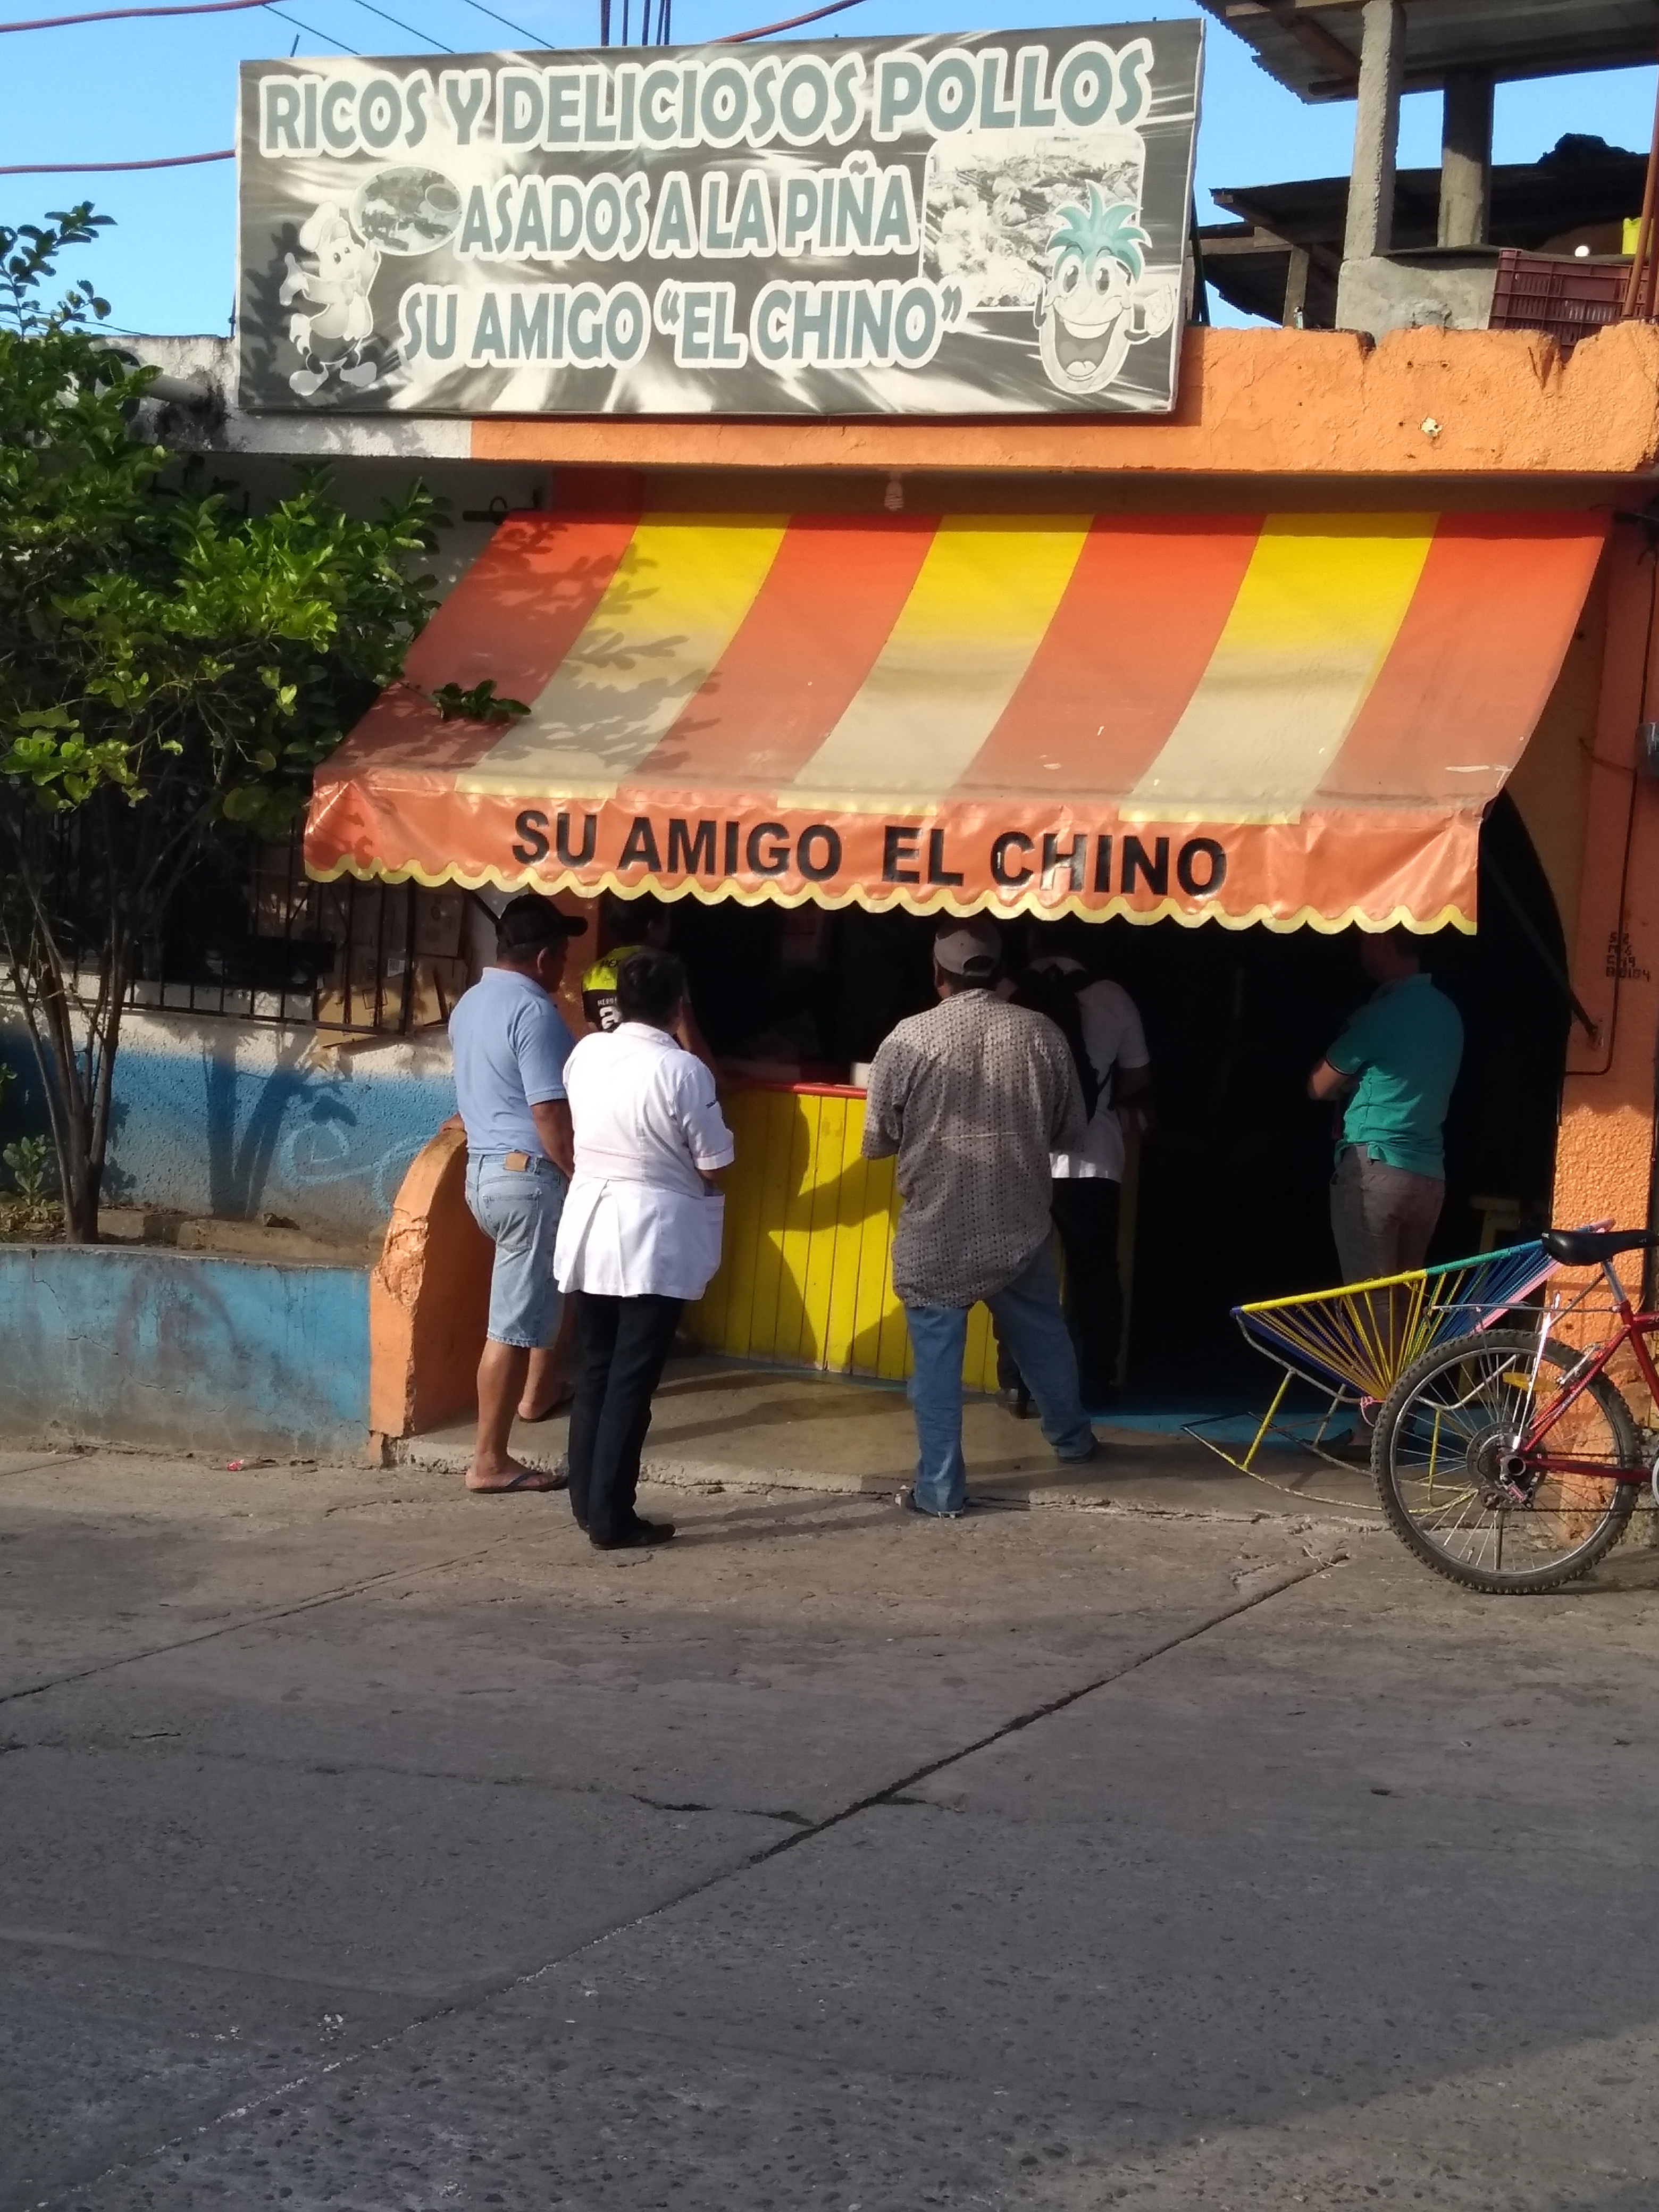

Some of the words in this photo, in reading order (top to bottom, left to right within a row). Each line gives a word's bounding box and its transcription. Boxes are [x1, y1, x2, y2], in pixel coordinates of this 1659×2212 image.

[264, 77, 429, 151] RICOS
[443, 77, 486, 147] Y
[501, 61, 861, 146] DELICIOSOS
[877, 46, 1147, 135] POLLOS
[458, 179, 646, 254] ASADOS
[653, 179, 692, 252] A
[705, 176, 771, 250] LA
[783, 159, 913, 249] PIÑA
[401, 290, 457, 363] SU
[471, 290, 641, 363] AMIGO
[512, 809, 597, 868] SU
[616, 817, 843, 882] AMIGO
[882, 825, 964, 886] EL
[990, 831, 1227, 897] CHINO
